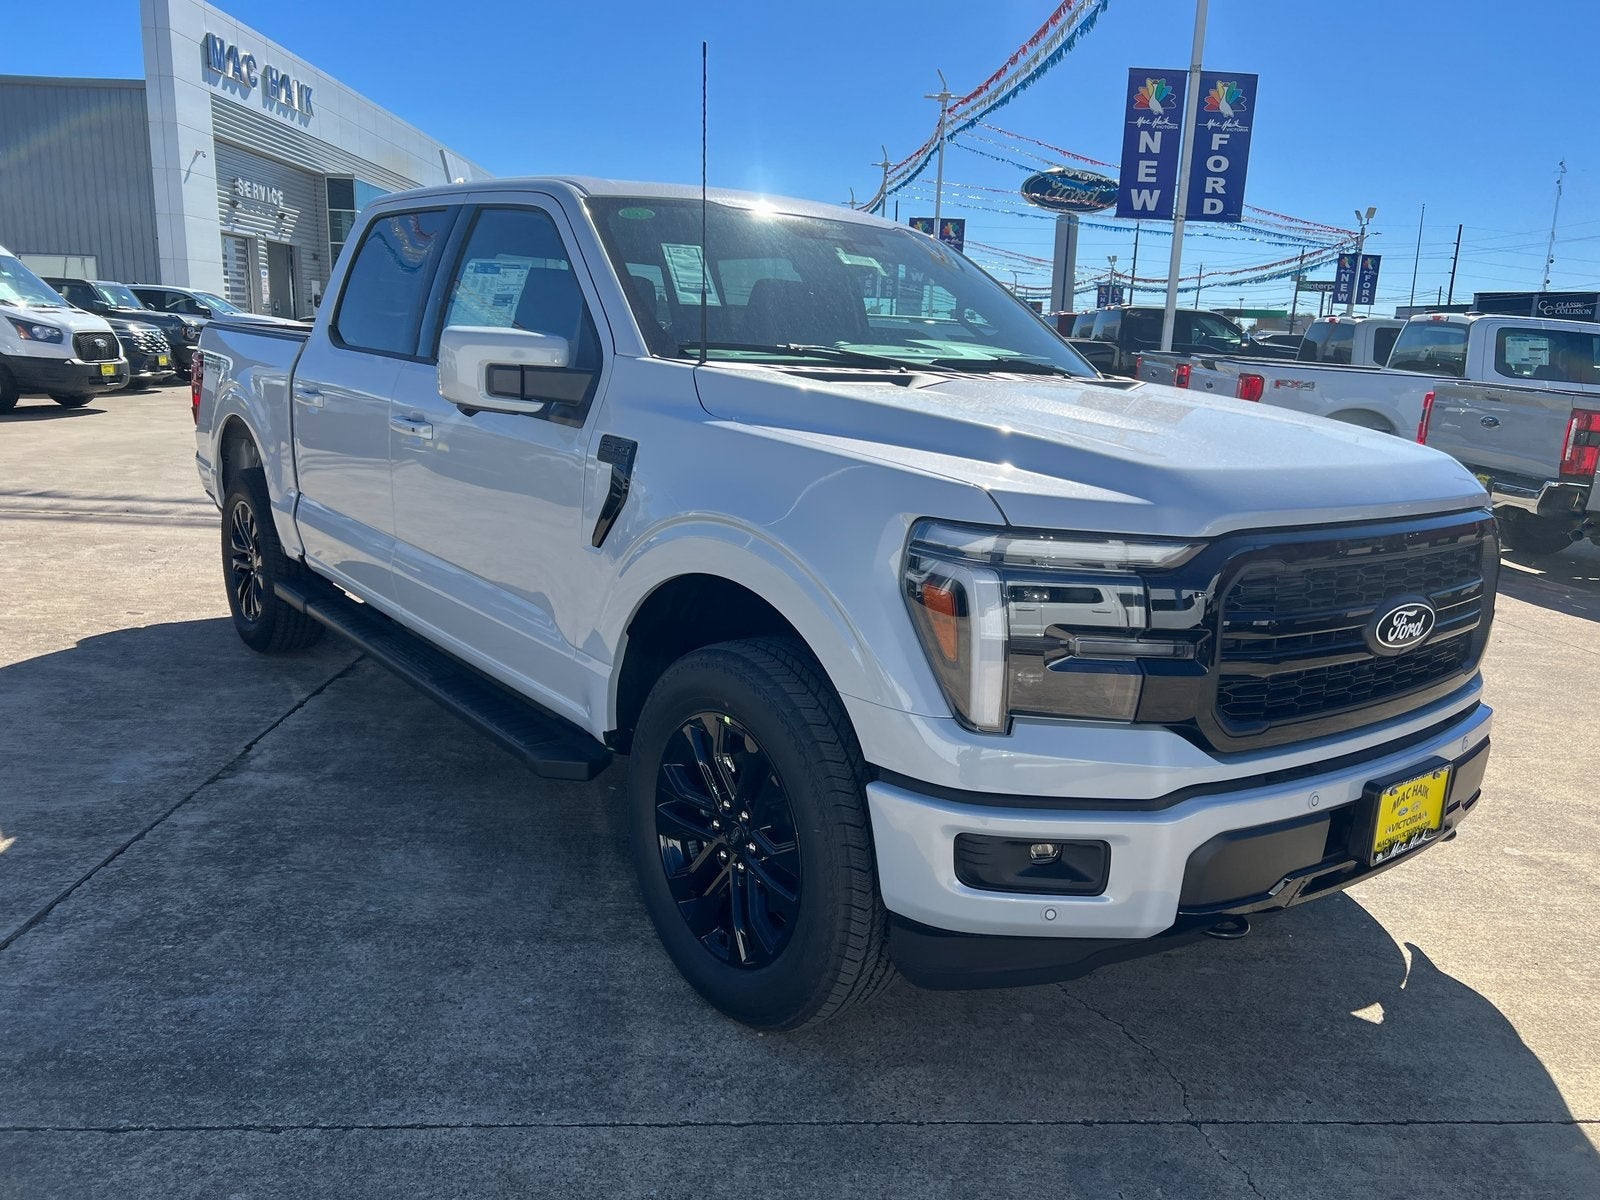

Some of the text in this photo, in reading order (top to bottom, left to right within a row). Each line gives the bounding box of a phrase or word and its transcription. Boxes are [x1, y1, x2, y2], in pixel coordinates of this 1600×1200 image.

[205, 32, 314, 117] MAC HAIK
[1131, 131, 1162, 212] NEW
[1203, 133, 1230, 215] FORD
[235, 177, 284, 207] SERVICE
[1337, 273, 1350, 302] NEW
[1361, 274, 1372, 303] FORD
[1387, 609, 1426, 642] Ford
[1391, 787, 1412, 813] MAC
[1412, 784, 1430, 799] HAIK
[1391, 812, 1423, 833] VICTORIA
